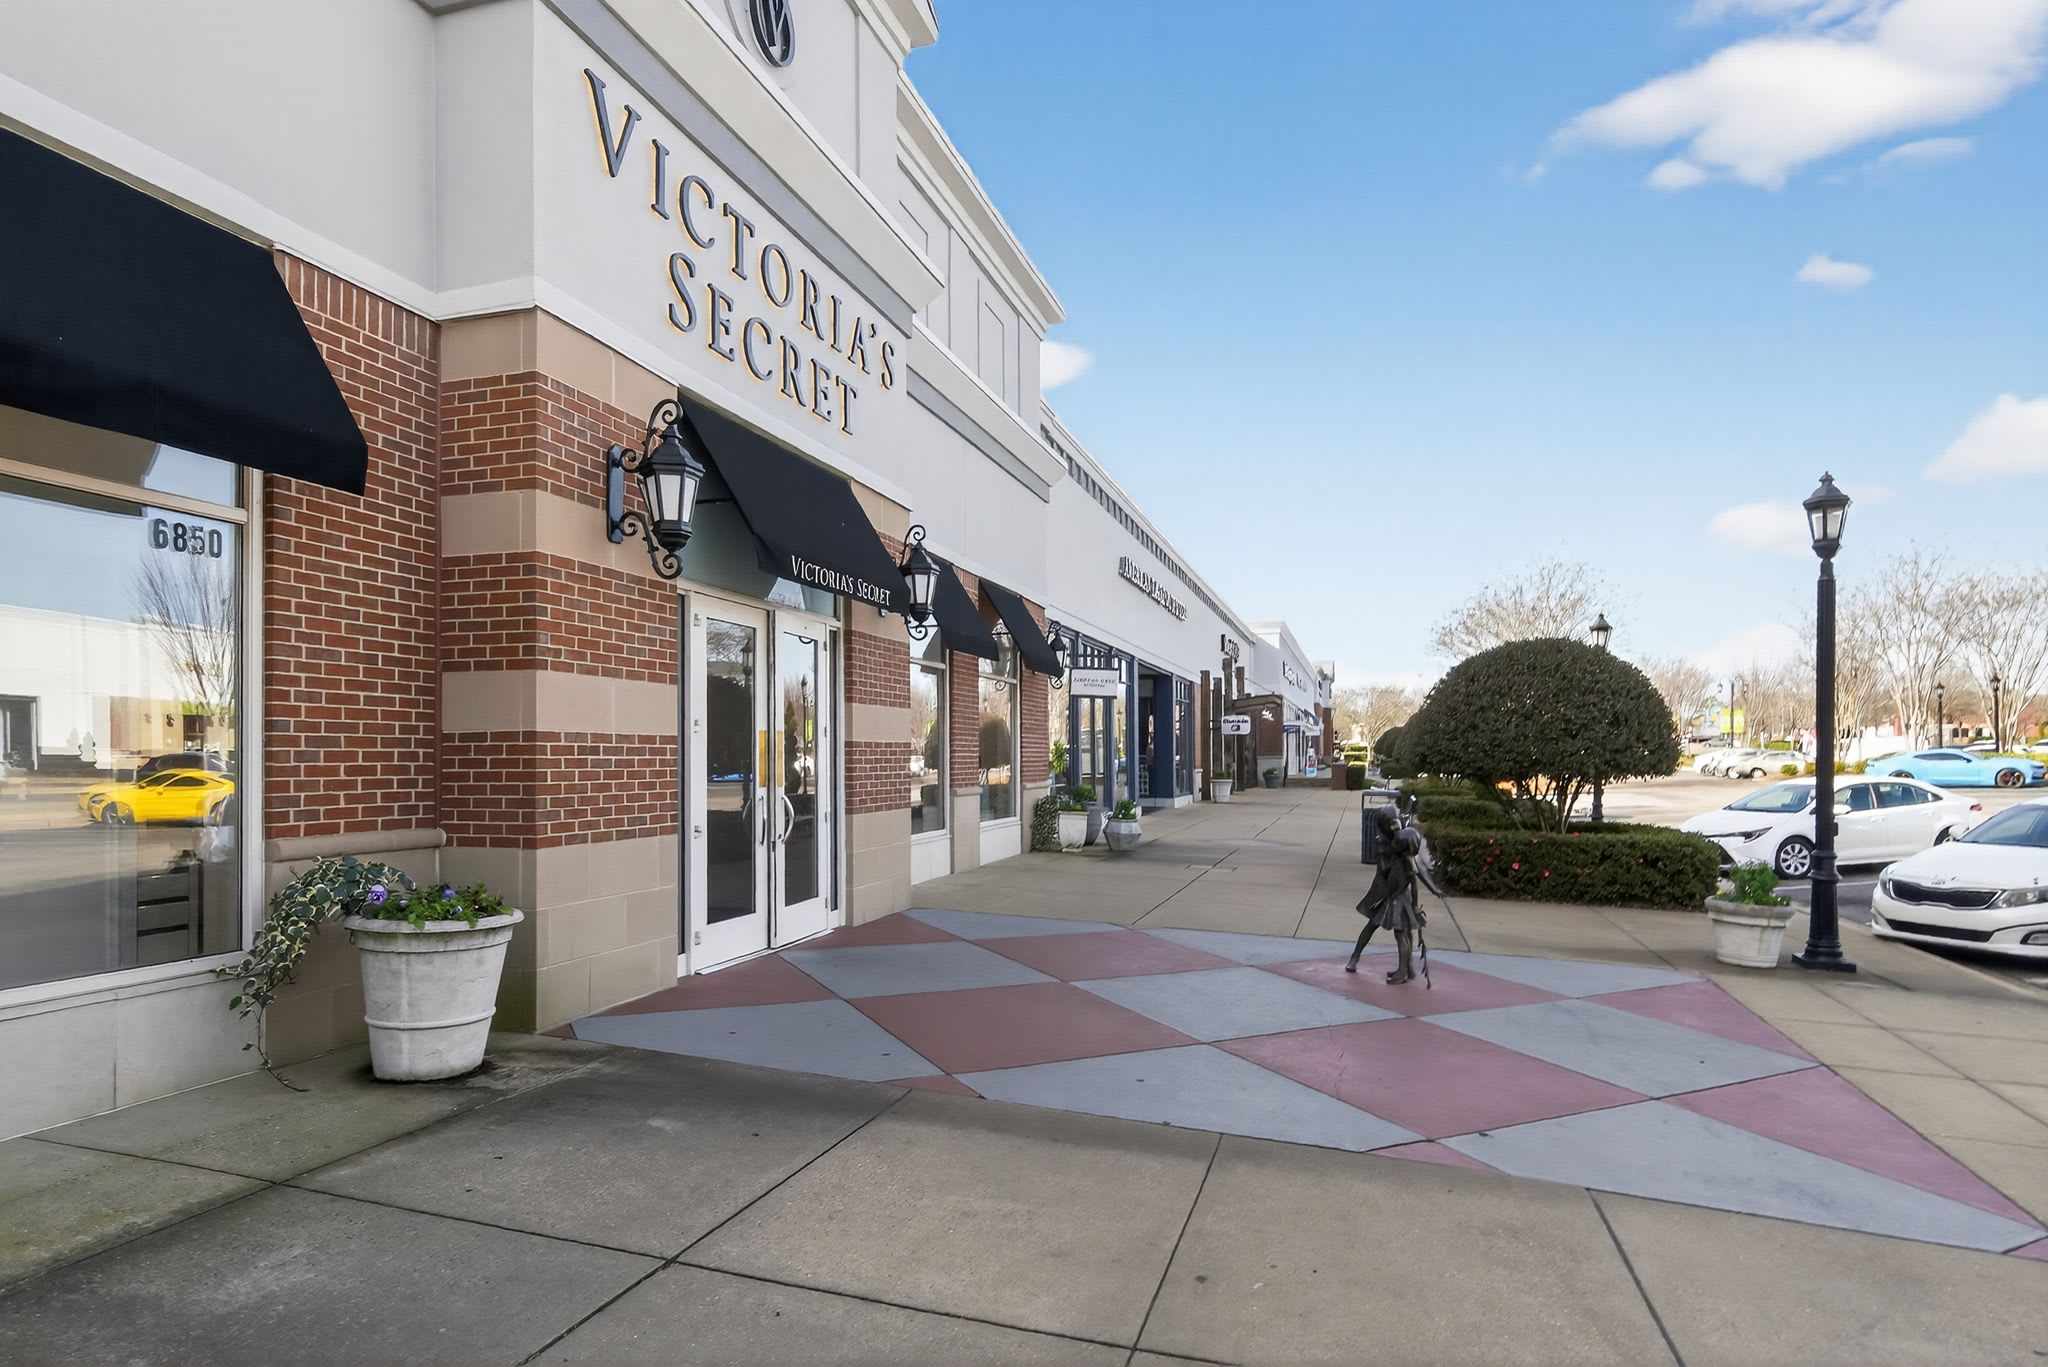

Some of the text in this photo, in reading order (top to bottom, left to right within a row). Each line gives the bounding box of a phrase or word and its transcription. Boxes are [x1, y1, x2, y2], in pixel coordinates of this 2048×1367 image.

[583, 67, 896, 391] VICTORIA'S
[667, 251, 858, 437] SECRET
[152, 518, 223, 559] 6850
[791, 554, 854, 594] VICTORIA'S
